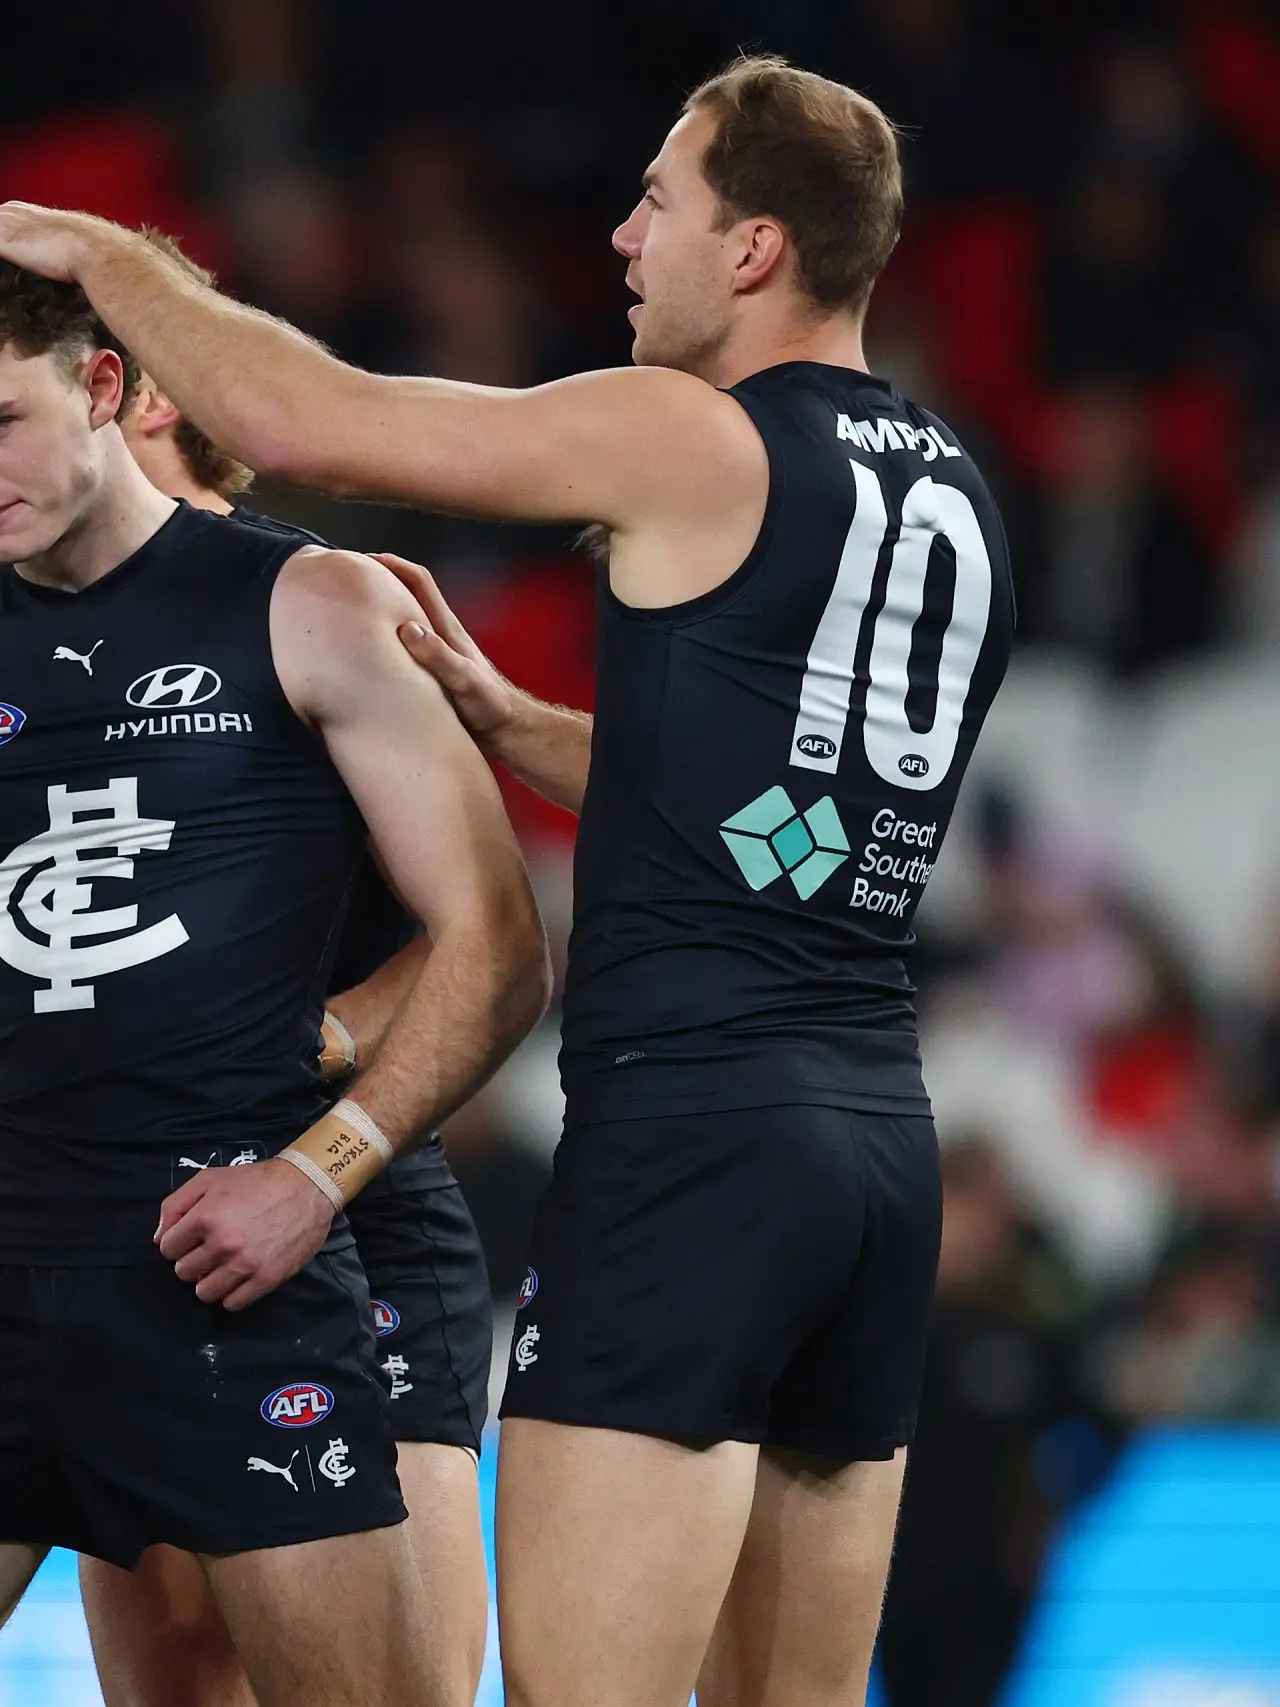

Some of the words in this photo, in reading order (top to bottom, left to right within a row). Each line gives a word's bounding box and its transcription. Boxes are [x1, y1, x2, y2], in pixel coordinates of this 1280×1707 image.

[837, 413, 962, 462] AMPOL
[789, 458, 992, 791] 10
[104, 712, 253, 741] HYUNDAI
[799, 738, 834, 756] AFL
[900, 758, 927, 774] AFL
[871, 808, 937, 848] Great
[858, 843, 935, 884] Southe
[849, 877, 912, 918] Bank
[326, 1133, 351, 1154] BIG
[327, 1137, 369, 1175] STRONG
[270, 1391, 329, 1420] AFL
